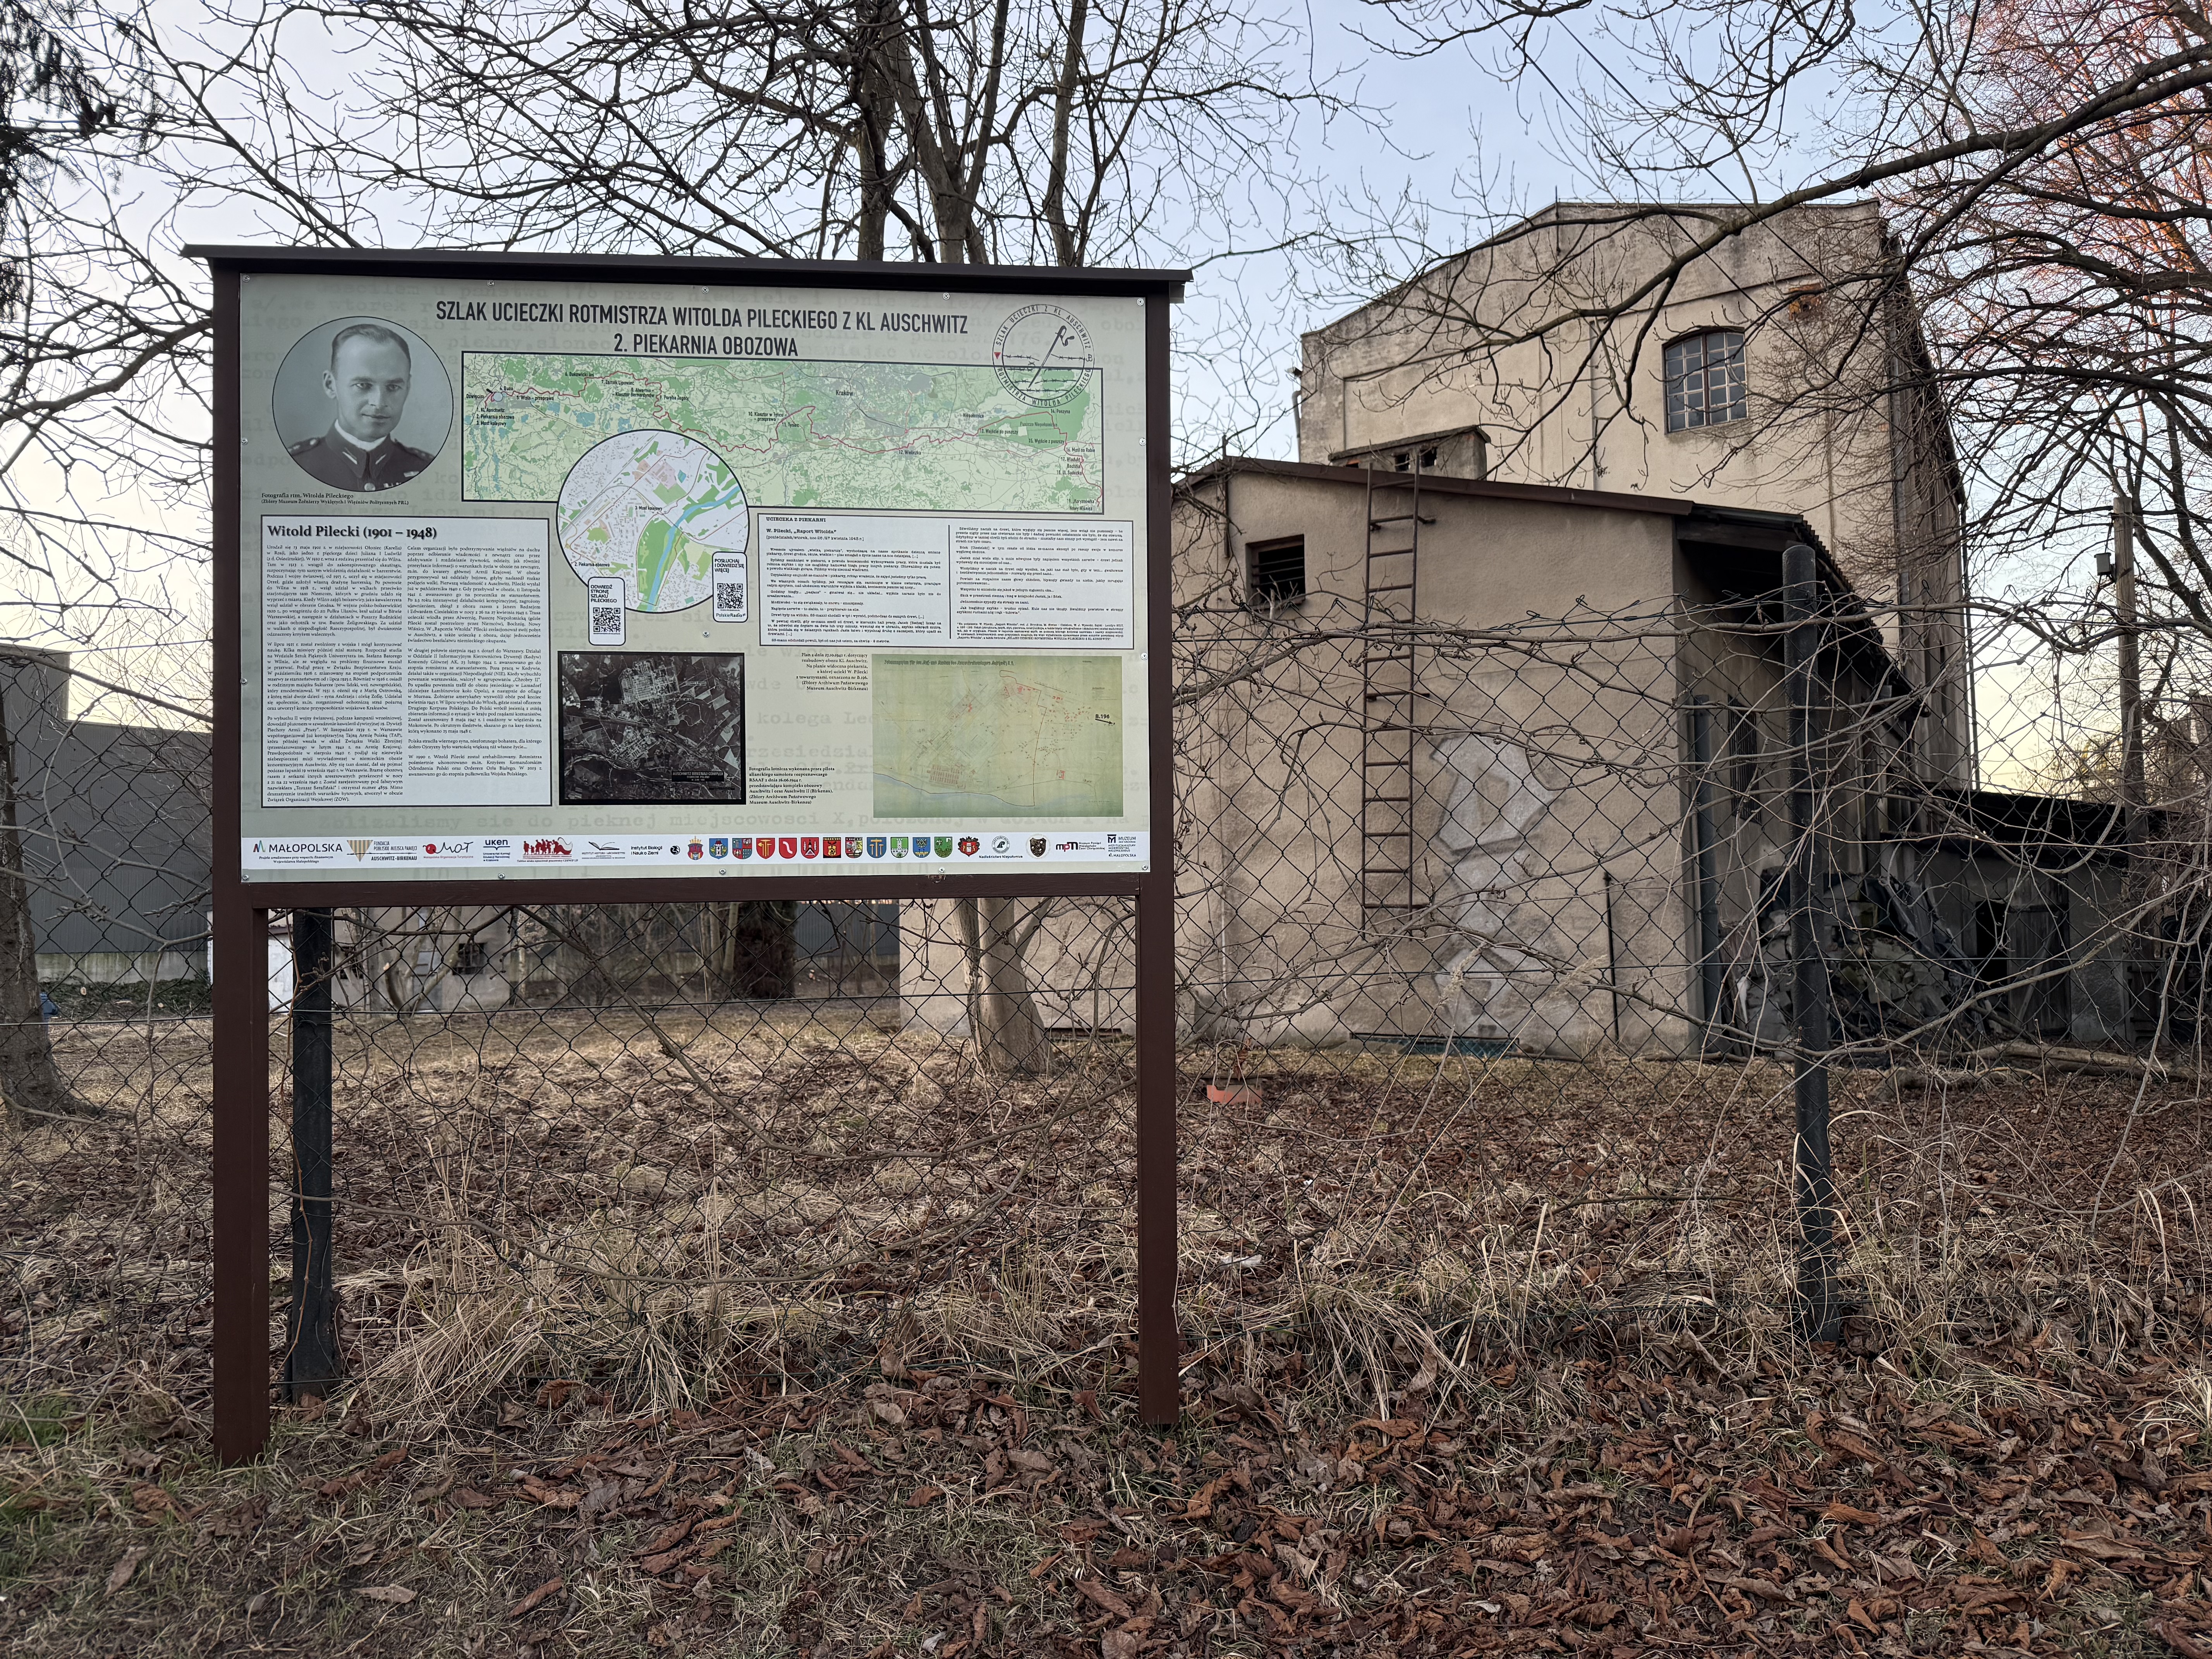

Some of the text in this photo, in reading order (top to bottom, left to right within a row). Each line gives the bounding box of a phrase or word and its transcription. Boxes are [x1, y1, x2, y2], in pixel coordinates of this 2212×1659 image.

[436, 301, 968, 334] SZLAK UCIECZKI ROTMISTRZA WITOLDA PILECKIEGO Z KL AUSCHWITZ
[996, 326, 1008, 346] SZLAK
[1009, 305, 1039, 323] UCIECZKI
[1054, 307, 1061, 316] KL
[1066, 315, 1091, 349] AUSCHWITZ
[614, 333, 799, 356] 2. PIEKARNIA OBOZOWA
[997, 368, 1026, 401] ROTMISTRZA
[1065, 369, 1091, 401] PILECKIEGO
[266, 525, 312, 537] Witold
[315, 526, 360, 537] Pilecki
[363, 526, 392, 539] (1901
[406, 527, 437, 540] 1948)
[269, 844, 343, 852] MAŁOPOLSKA
